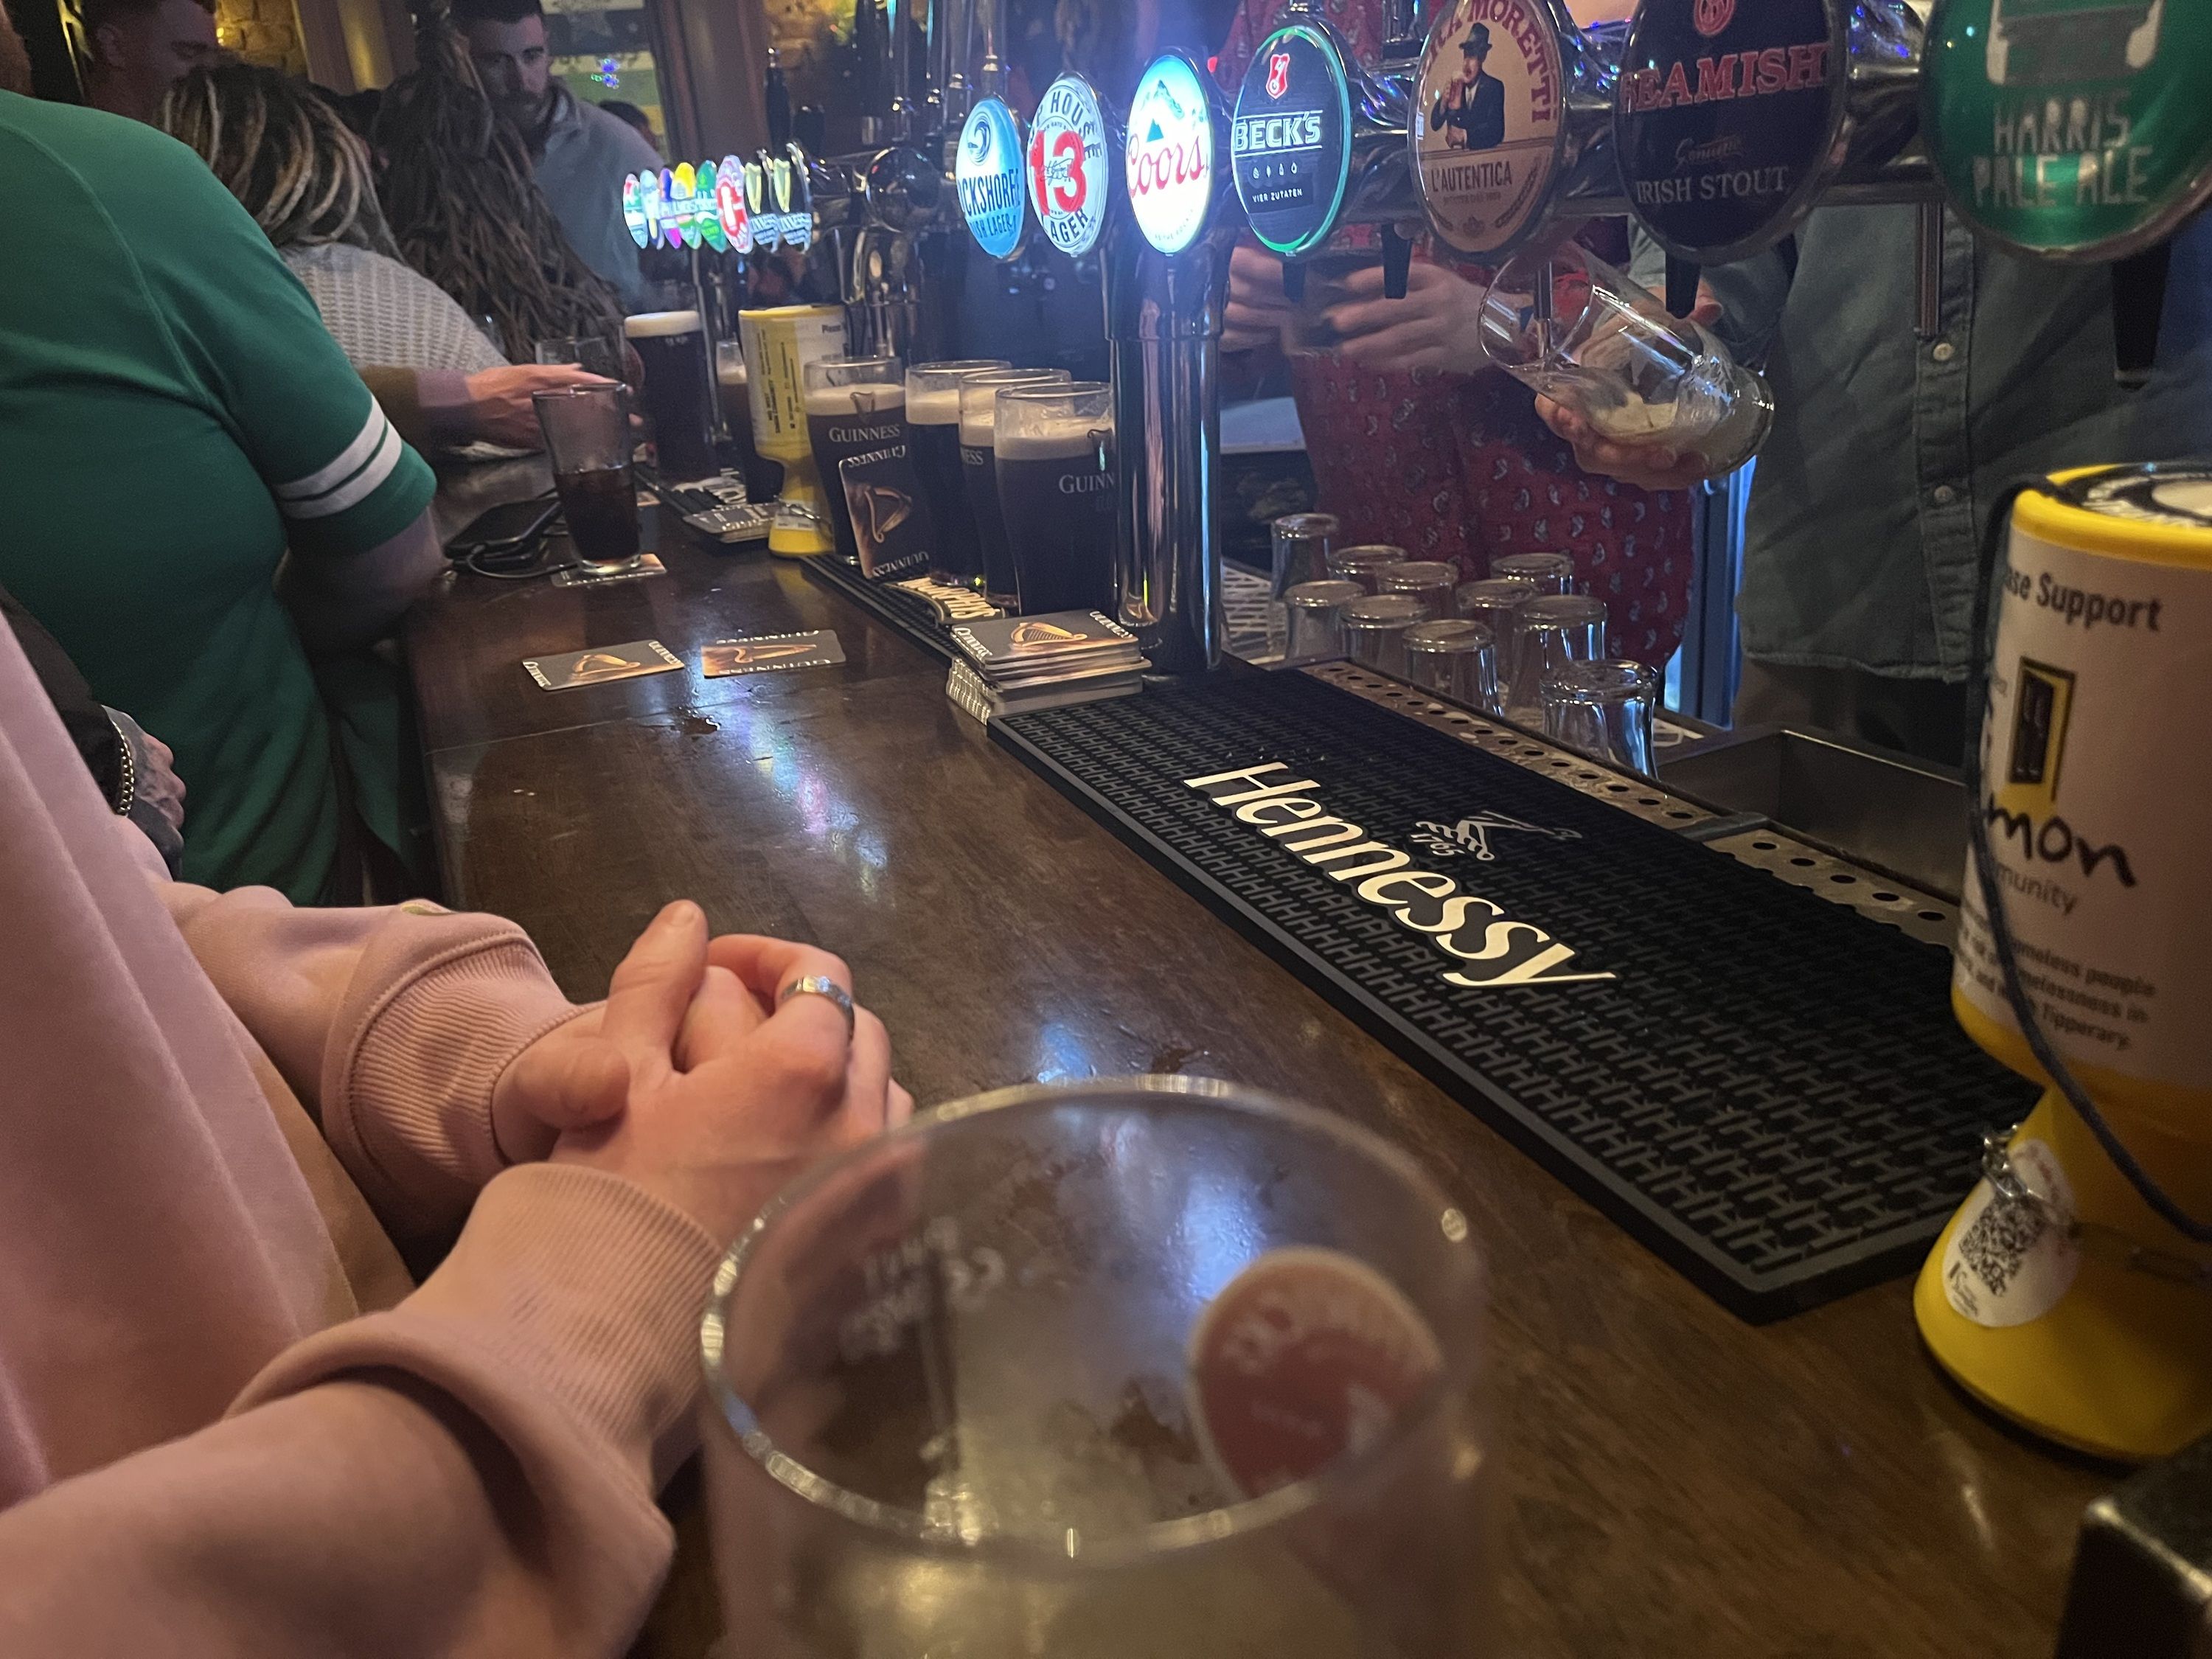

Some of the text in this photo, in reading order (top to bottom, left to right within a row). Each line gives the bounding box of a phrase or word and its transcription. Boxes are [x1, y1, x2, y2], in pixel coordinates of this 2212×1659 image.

[1467, 0, 1551, 123] MORETTI
[1235, 111, 1321, 152] BECK'S
[1994, 91, 2132, 156] HARRIS
[1030, 130, 1087, 216] 13
[1127, 133, 1206, 198] Coors
[1431, 161, 1513, 192] L'AUTENTICA
[1637, 166, 1790, 204] IRISH STOUT
[1973, 145, 2152, 209] PALE ALE
[1252, 192, 1268, 203] VIER
[829, 424, 901, 442] GUINNESS
[847, 445, 906, 468] GUINNESS
[2037, 572, 2161, 632] Support
[1986, 792, 2137, 888] mon
[1183, 762, 1616, 987] Hennessy
[1998, 862, 2078, 917] munity
